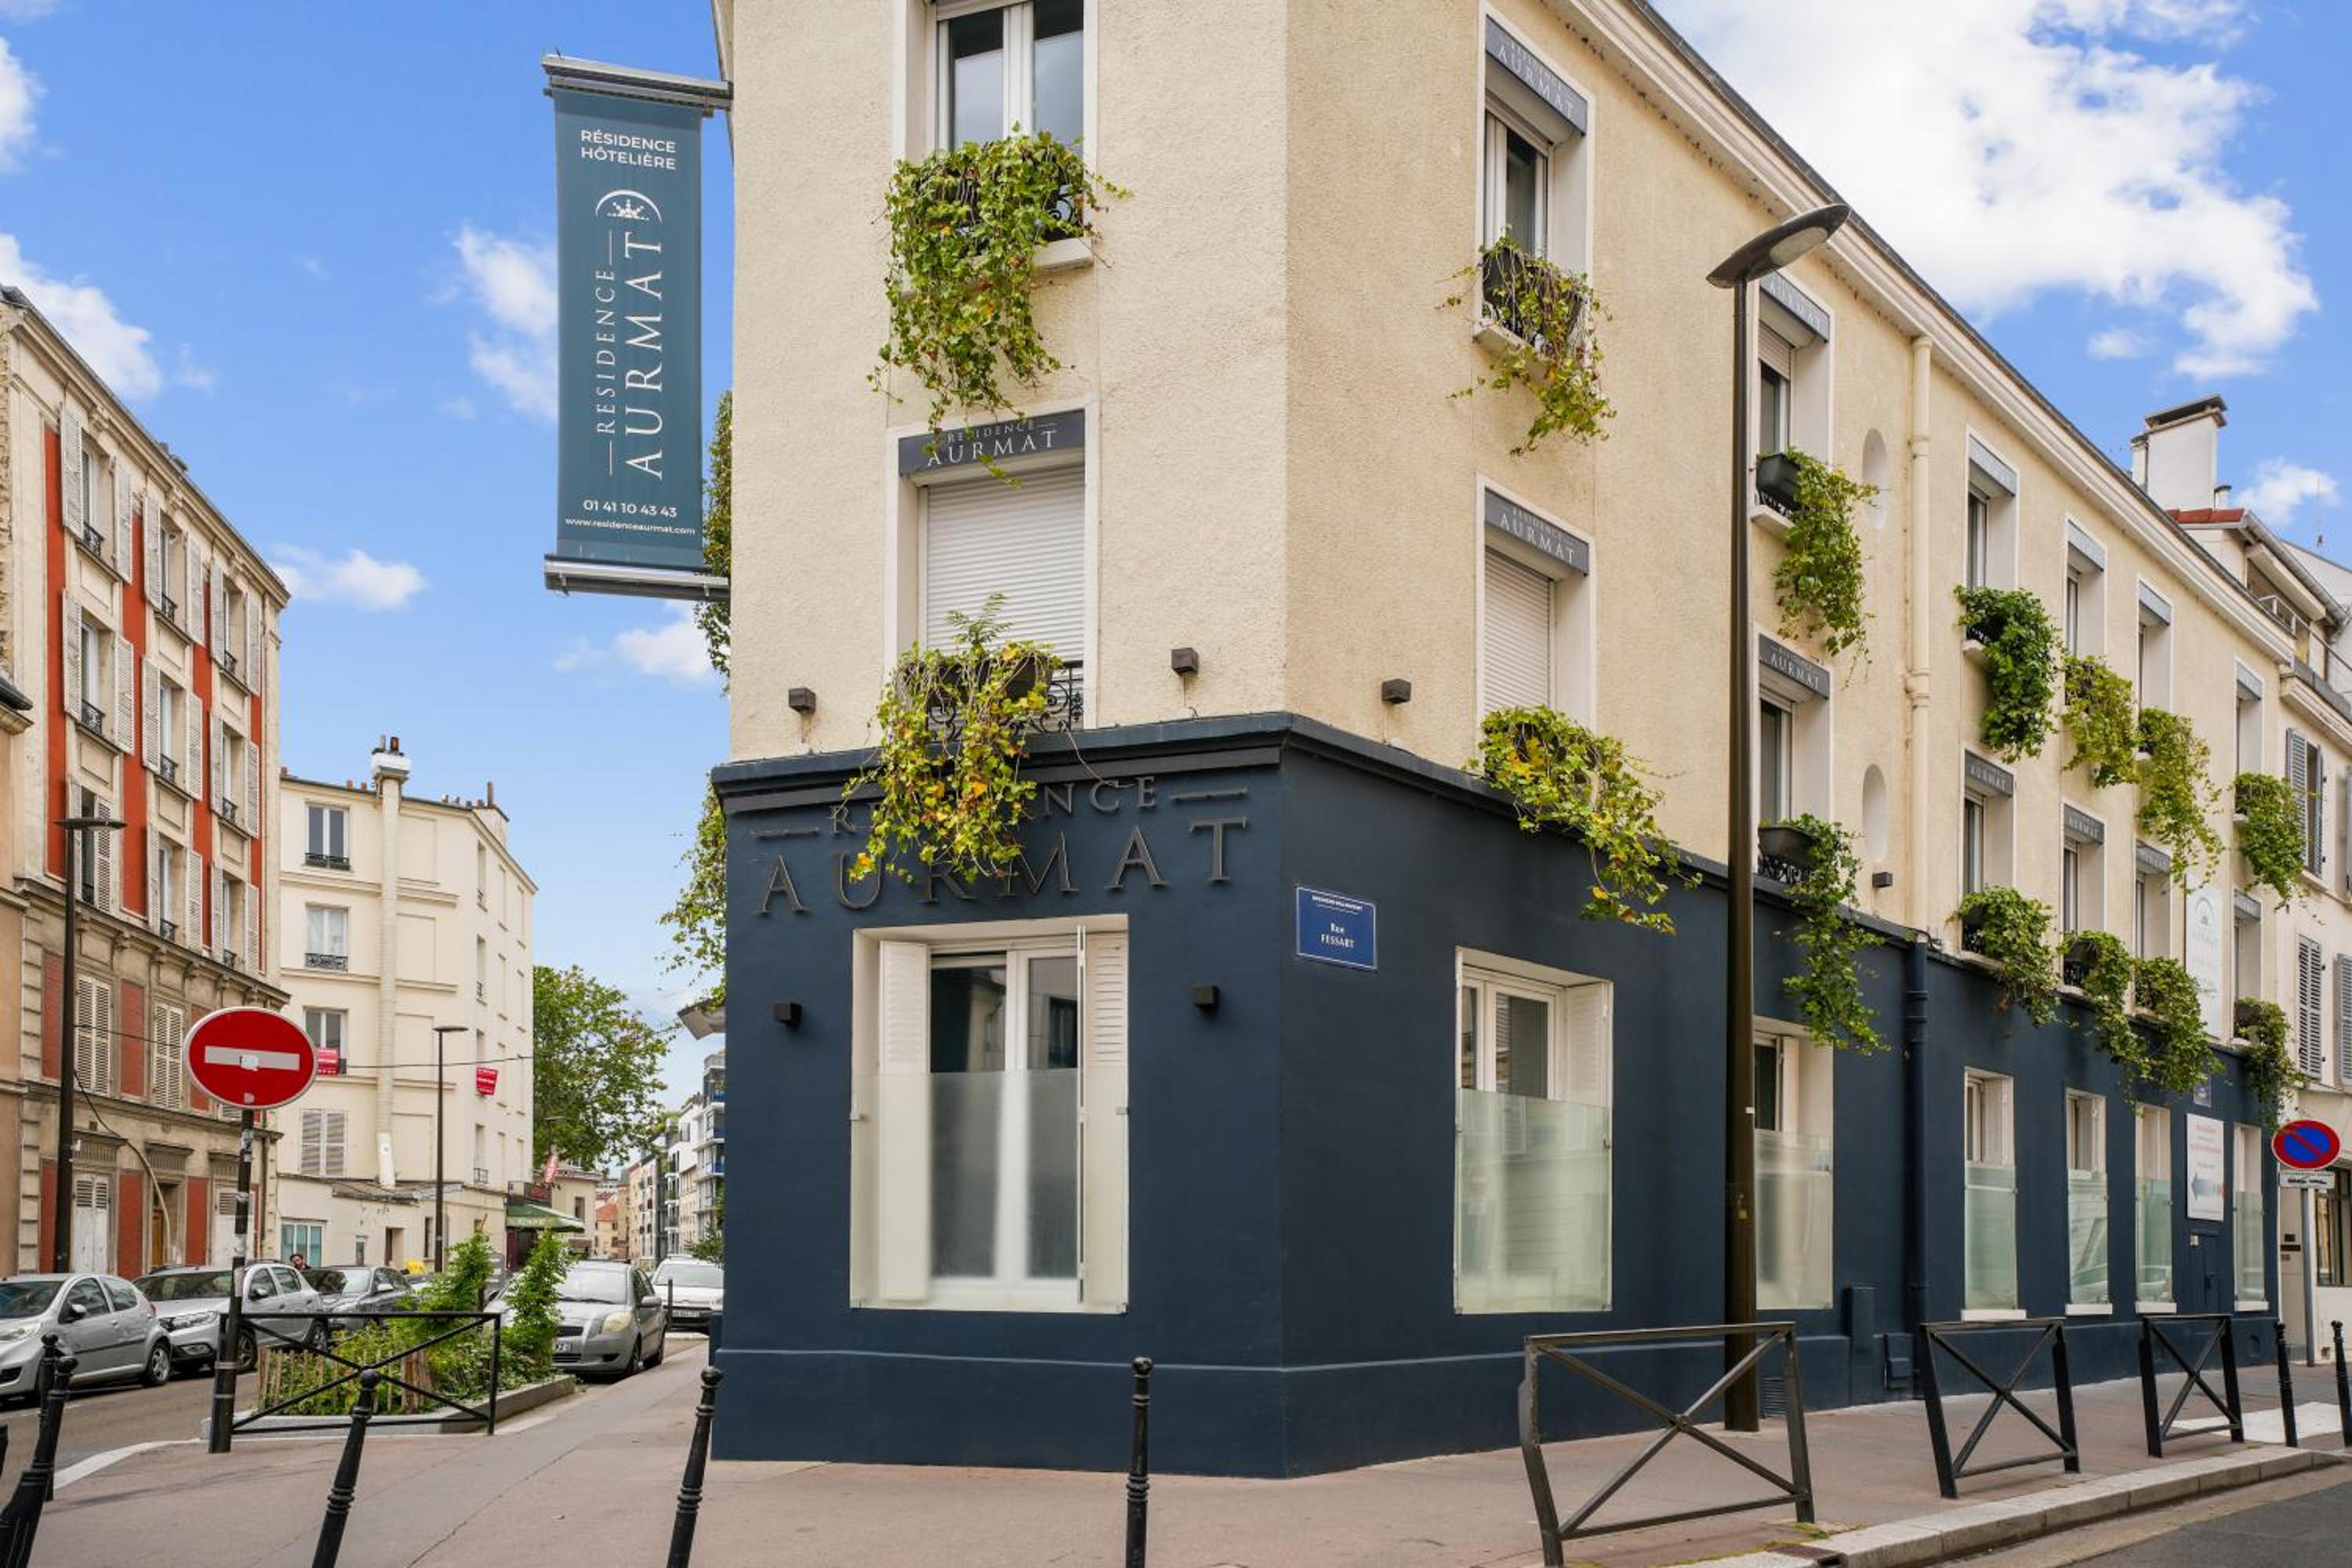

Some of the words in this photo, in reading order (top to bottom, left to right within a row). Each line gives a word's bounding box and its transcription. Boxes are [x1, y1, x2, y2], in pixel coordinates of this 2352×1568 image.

[581, 129, 677, 153] RÉSIDENCE
[581, 146, 677, 170] HÔTELIÈRE
[596, 270, 615, 434] RESIDENCE
[625, 231, 662, 480] AURMAT
[927, 430, 1057, 466] AURMAT
[583, 499, 598, 512] 01
[603, 501, 617, 513] 41
[620, 503, 637, 514] 10
[641, 504, 657, 516] 43
[659, 506, 677, 518] 43
[564, 518, 695, 535] www.residenceaurmat.com
[1501, 514, 1575, 563] AURMAT
